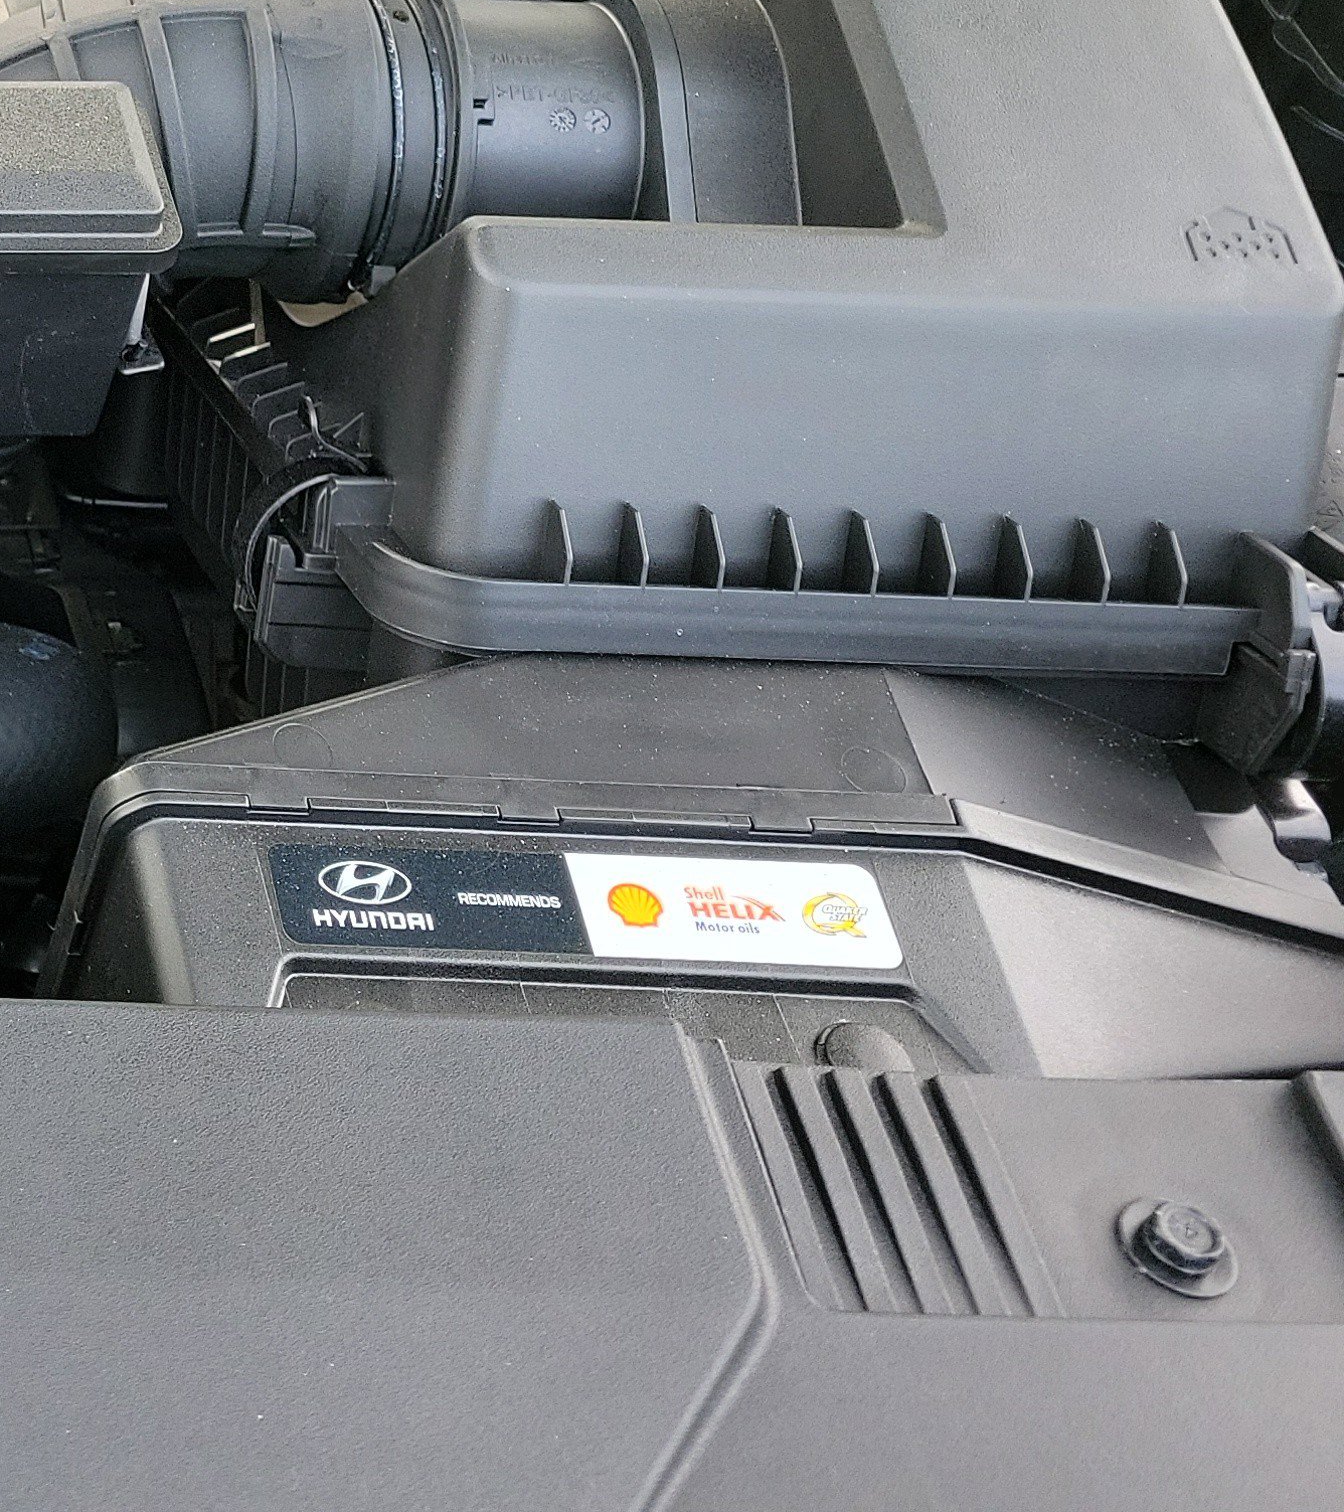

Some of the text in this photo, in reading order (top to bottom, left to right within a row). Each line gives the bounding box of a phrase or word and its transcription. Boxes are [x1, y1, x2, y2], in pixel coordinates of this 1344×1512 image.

[683, 886, 725, 901] Shell
[313, 892, 562, 932] HYUNDAI RECOMMENDS
[687, 899, 784, 922] HELIX
[695, 921, 761, 934] Motor oils
